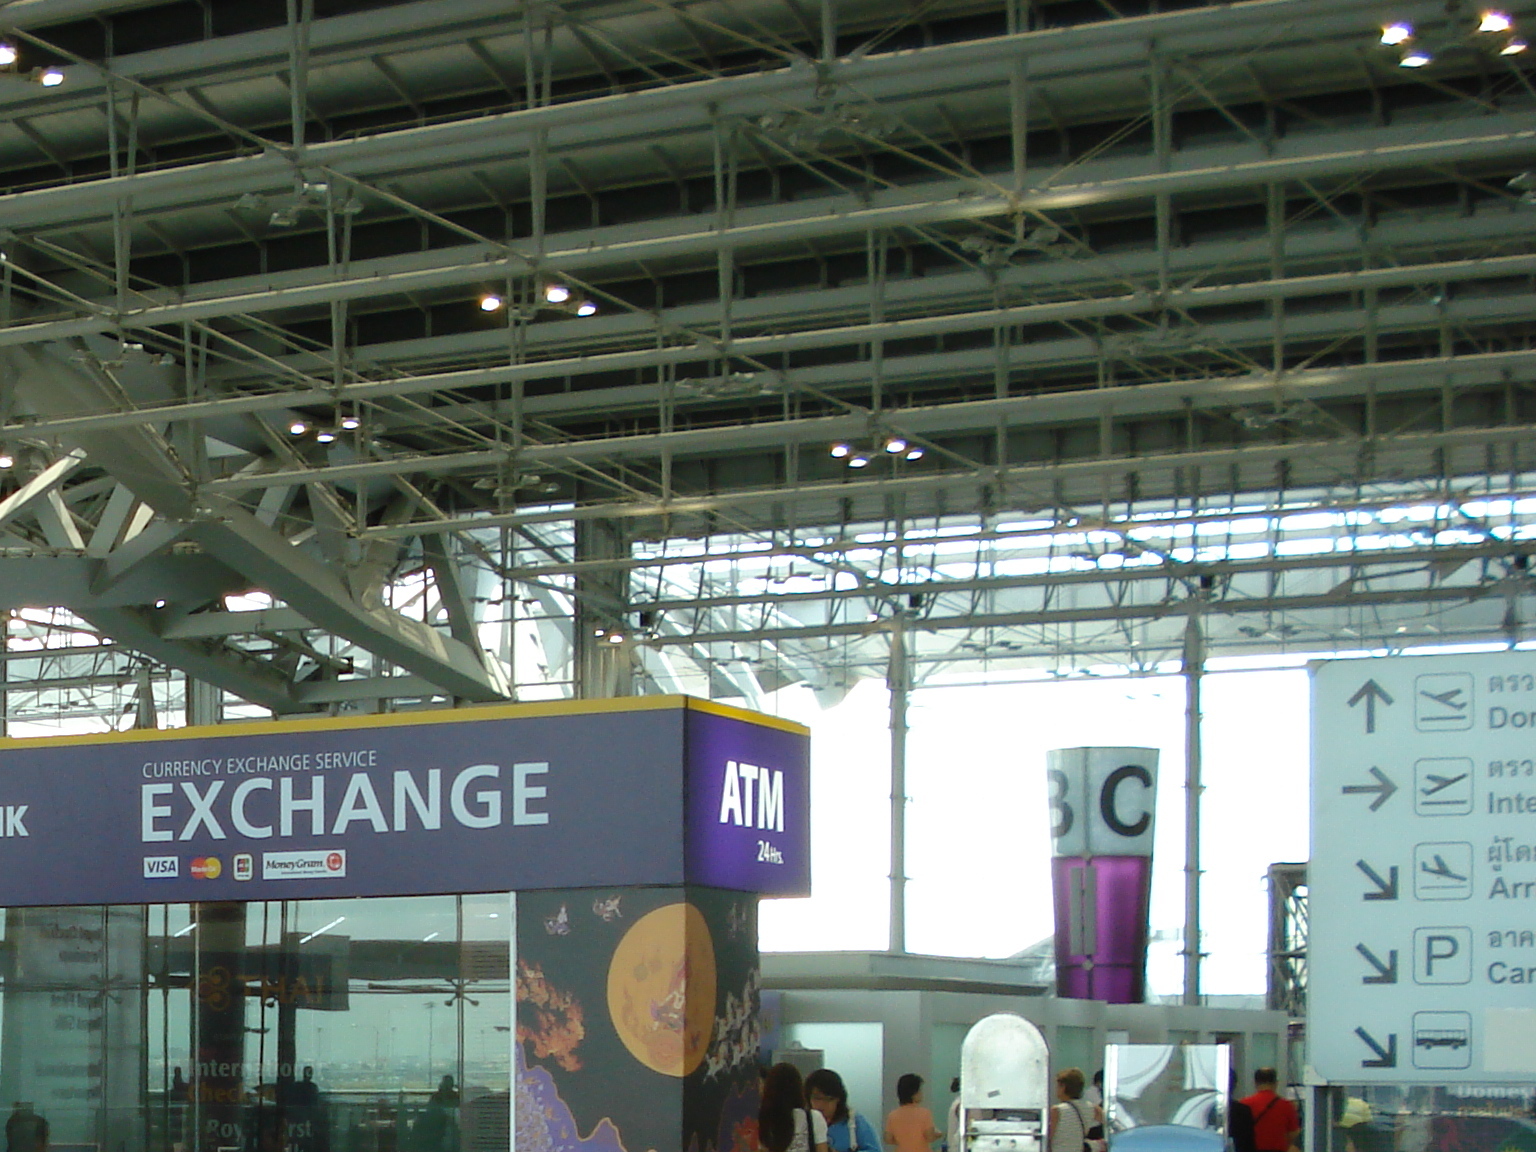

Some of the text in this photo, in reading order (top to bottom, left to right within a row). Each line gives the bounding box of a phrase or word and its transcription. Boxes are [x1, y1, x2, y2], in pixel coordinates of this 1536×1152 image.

[142, 750, 378, 779] CURRENCY EXCHANGE SERVICE
[719, 760, 784, 832] ATM
[141, 762, 549, 842] EXCHANGE
[1100, 765, 1152, 837] C
[147, 860, 177, 874] VISA
